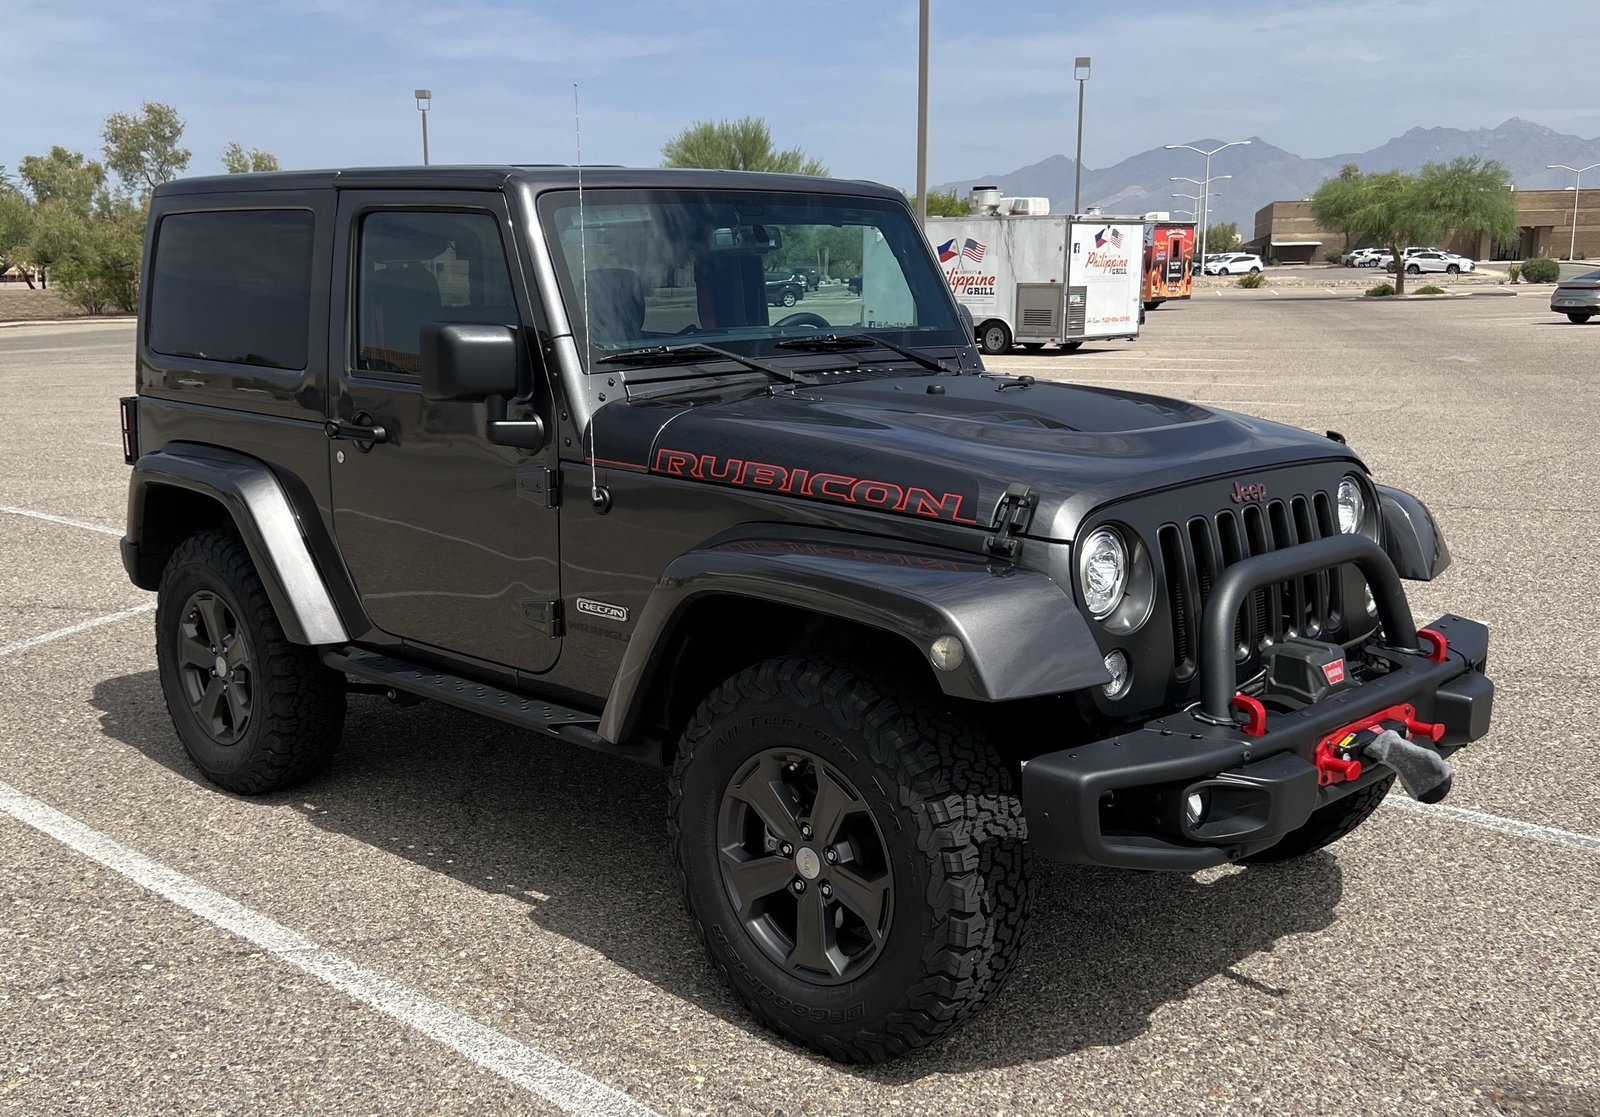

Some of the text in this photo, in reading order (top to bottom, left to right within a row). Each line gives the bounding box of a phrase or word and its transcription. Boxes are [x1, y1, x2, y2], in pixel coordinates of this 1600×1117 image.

[1085, 251, 1128, 274] Philippine
[946, 267, 996, 294] lippine
[966, 287, 995, 296] GRILL
[651, 448, 977, 525] RUBICON
[1230, 481, 1266, 503] Jeep
[579, 601, 624, 618] RECON
